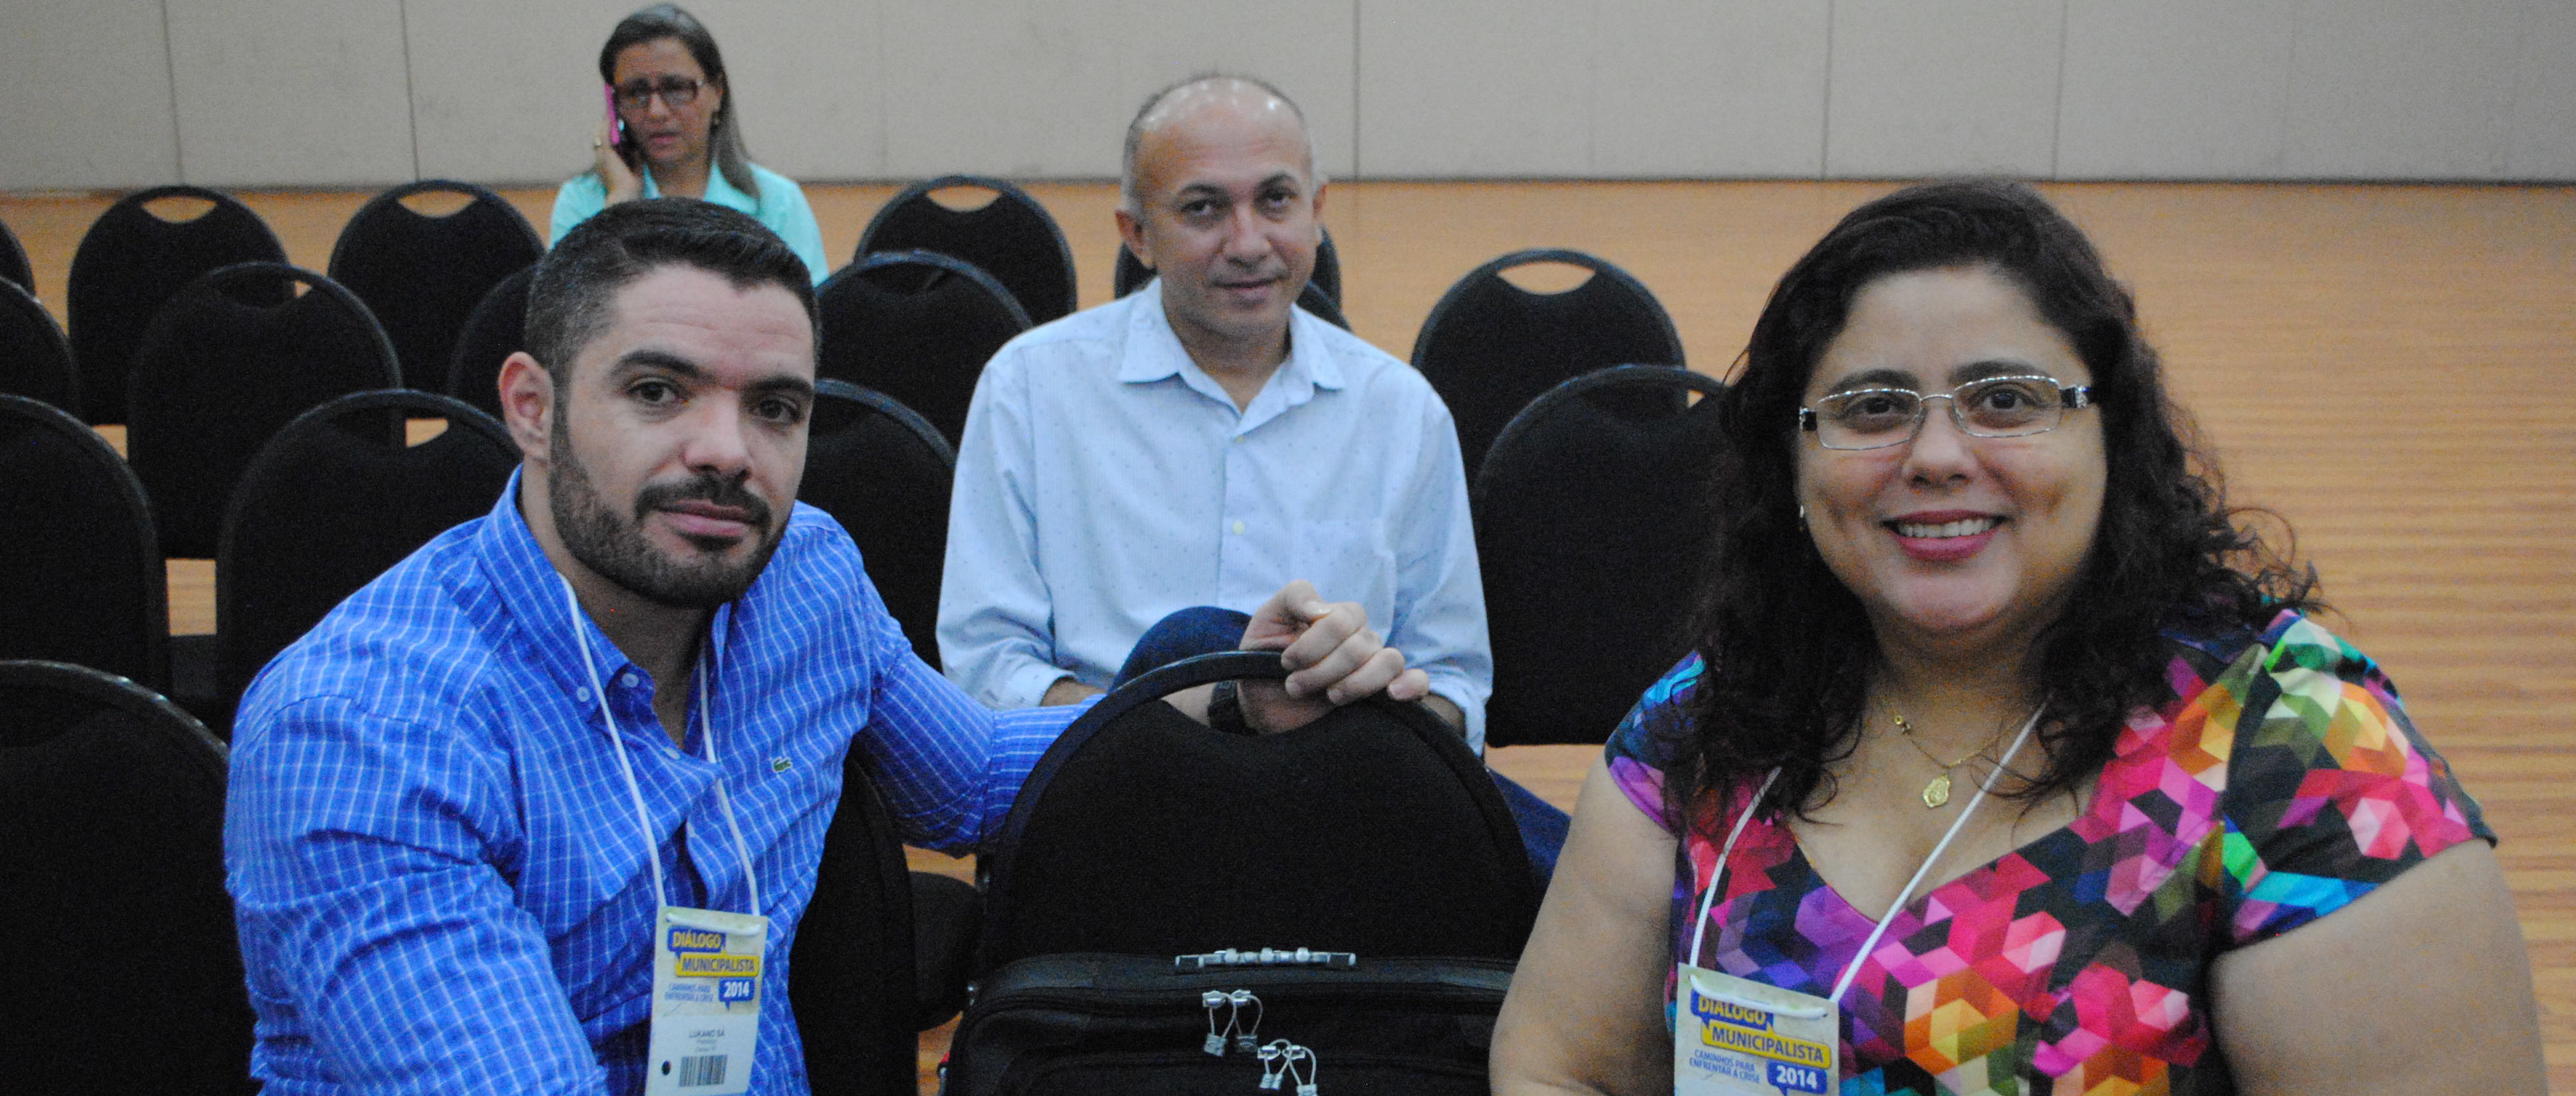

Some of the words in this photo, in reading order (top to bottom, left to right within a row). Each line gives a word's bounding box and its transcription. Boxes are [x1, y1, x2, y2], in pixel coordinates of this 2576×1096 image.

[673, 929, 721, 949] DIÁLOGO
[681, 958, 756, 972] MUNICIPALISTA
[724, 981, 750, 998] 2014
[1712, 1027, 1824, 1063] MUNICIPALISTA
[1735, 1060, 1755, 1072] PARA
[1776, 1065, 1818, 1089] 2014
